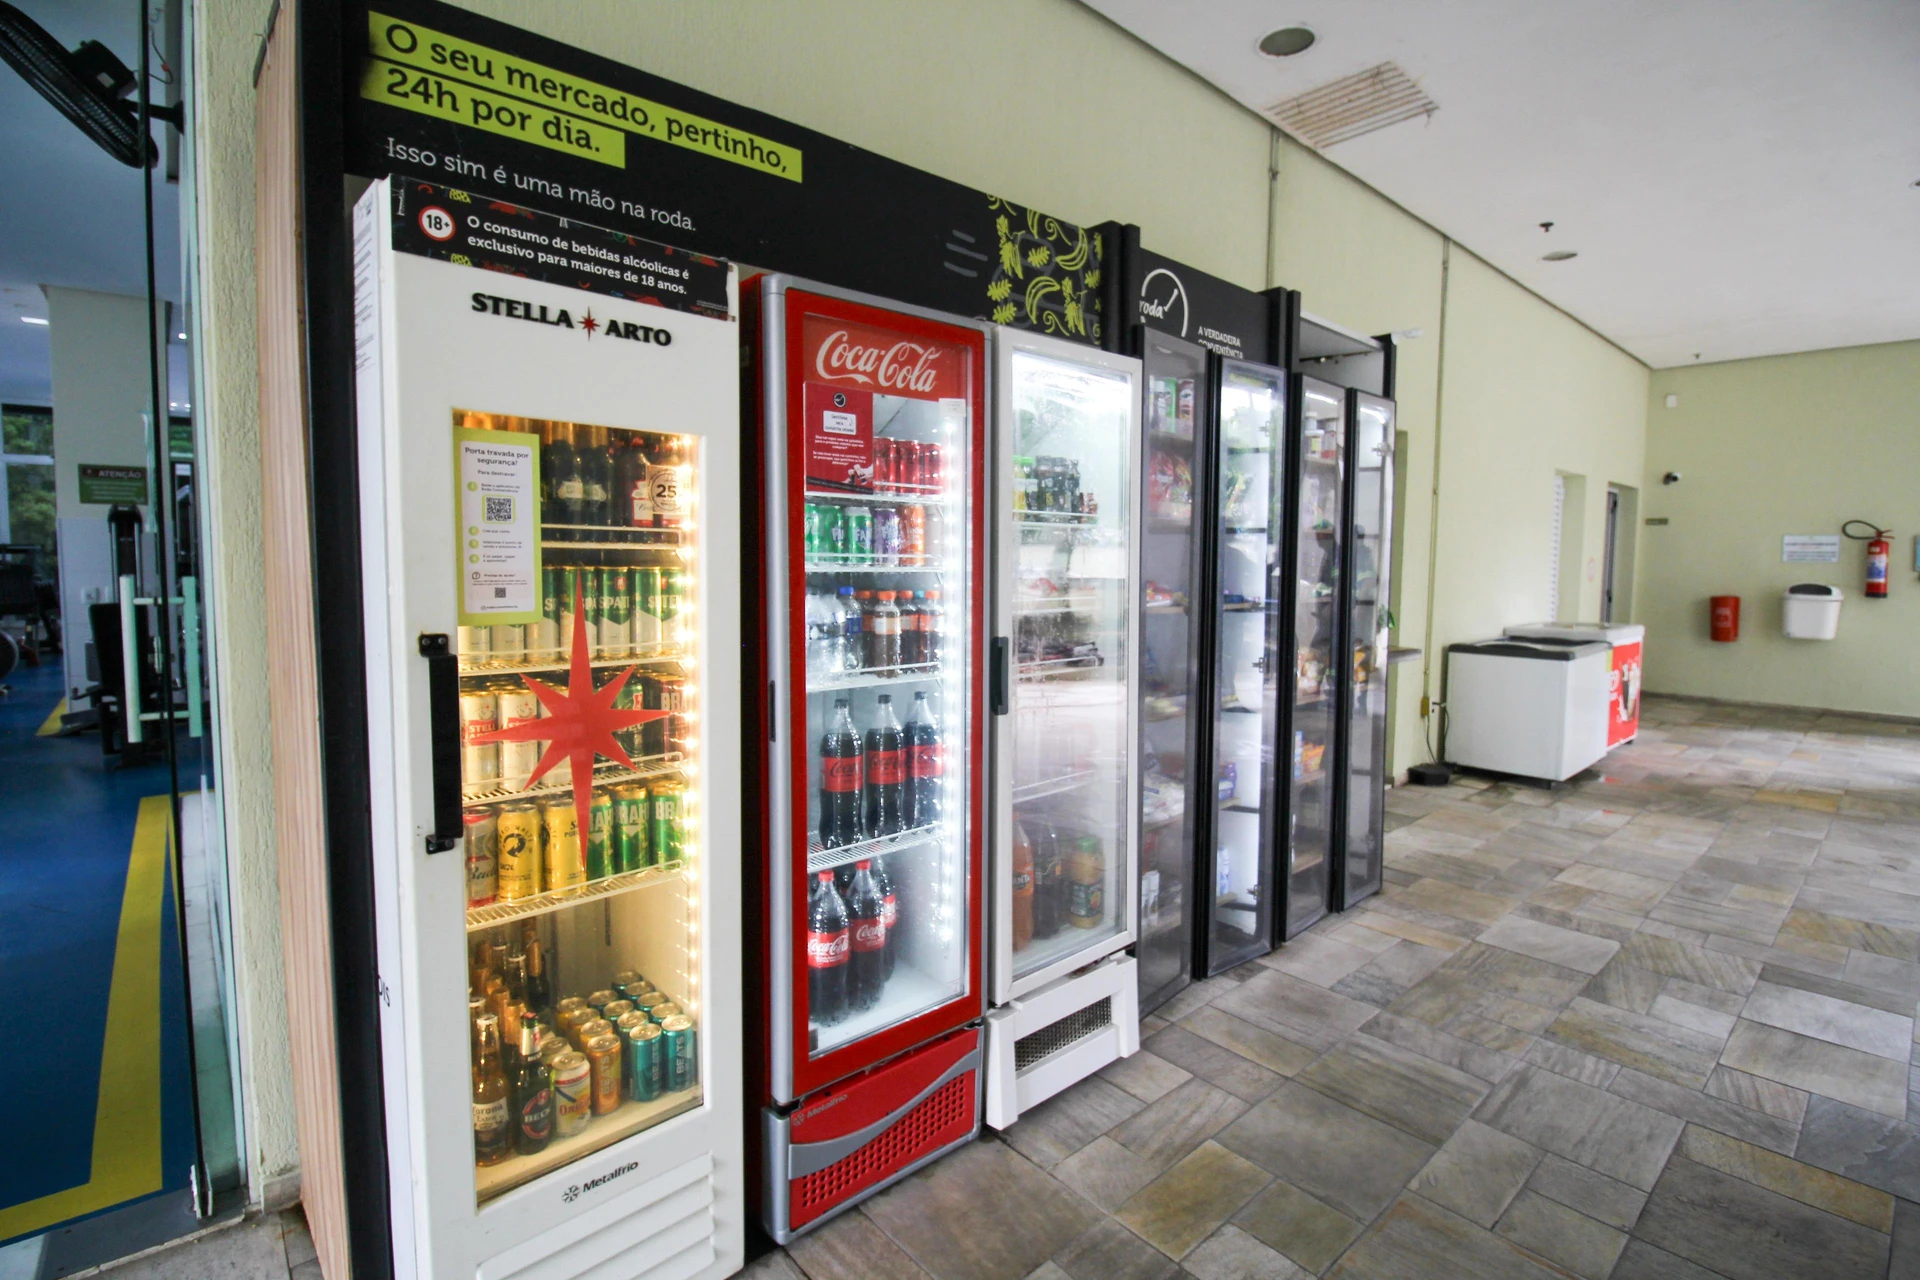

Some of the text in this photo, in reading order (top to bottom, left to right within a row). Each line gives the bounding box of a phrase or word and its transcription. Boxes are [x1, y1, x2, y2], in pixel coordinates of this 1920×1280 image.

[386, 24, 787, 173] O seu mercado, pertinho,
[387, 68, 600, 152] 24h por dia.
[386, 137, 697, 231] Isso sim é uma mão na roda.
[425, 213, 451, 232] 18+
[467, 215, 480, 229] O
[483, 221, 550, 245] consumo
[552, 237, 569, 250] de
[571, 240, 620, 263] bebidas
[682, 269, 690, 280] é
[467, 234, 688, 294] exclusivo para maiores de 18 anos.
[471, 292, 673, 347] STELLA ARTO
[1138, 298, 1165, 320] roda
[1197, 325, 1242, 348] A VERDADEIRA
[815, 330, 943, 392] Coca-Cola
[464, 446, 486, 455] Porta
[486, 449, 515, 458] travada
[477, 458, 519, 467] segurança!
[98, 469, 142, 480] ATENÇÃO
[656, 484, 677, 498] 25
[675, 1036, 685, 1074] BEATS
[806, 1093, 849, 1119] Metalfrio
[582, 1160, 639, 1194] Metalfrio
